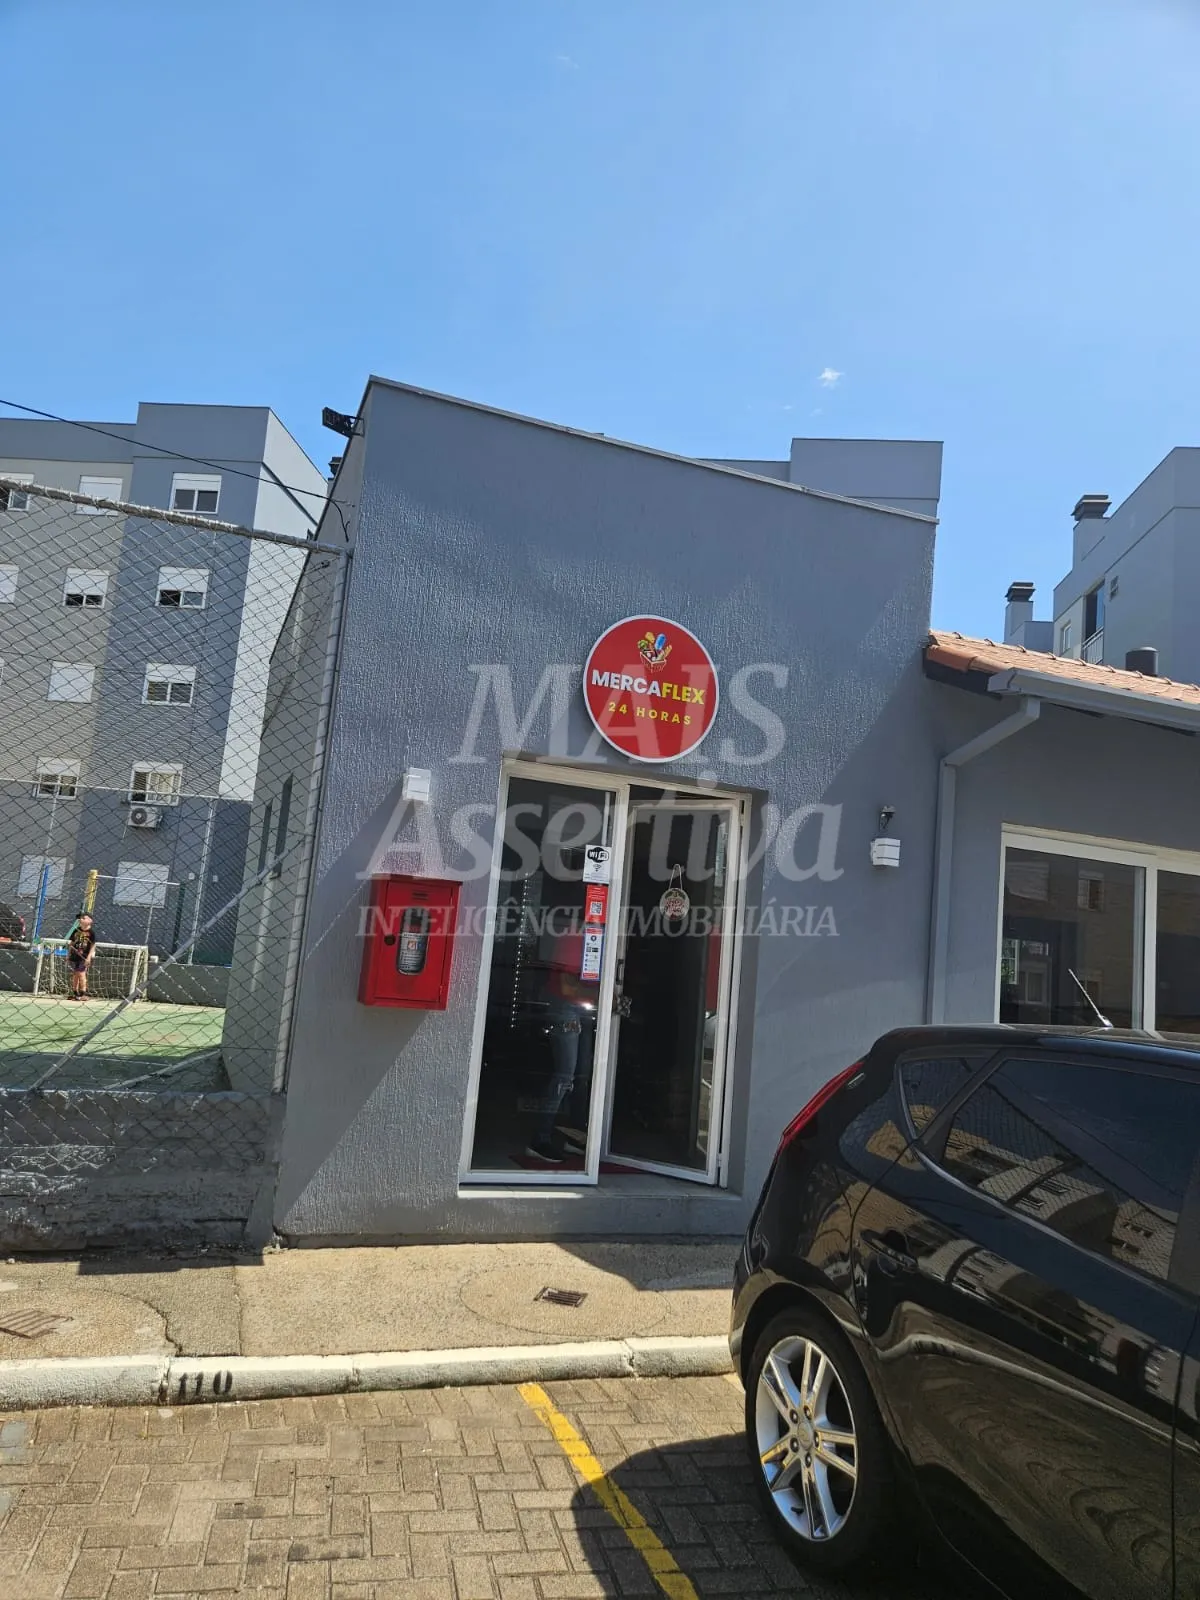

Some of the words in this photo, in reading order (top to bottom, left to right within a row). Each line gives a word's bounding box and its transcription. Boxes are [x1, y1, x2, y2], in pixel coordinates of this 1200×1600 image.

[591, 669, 705, 705] MERCAFLEX
[608, 701, 628, 715] 24
[636, 706, 692, 726] HORAS
[179, 1369, 233, 1400] 110
